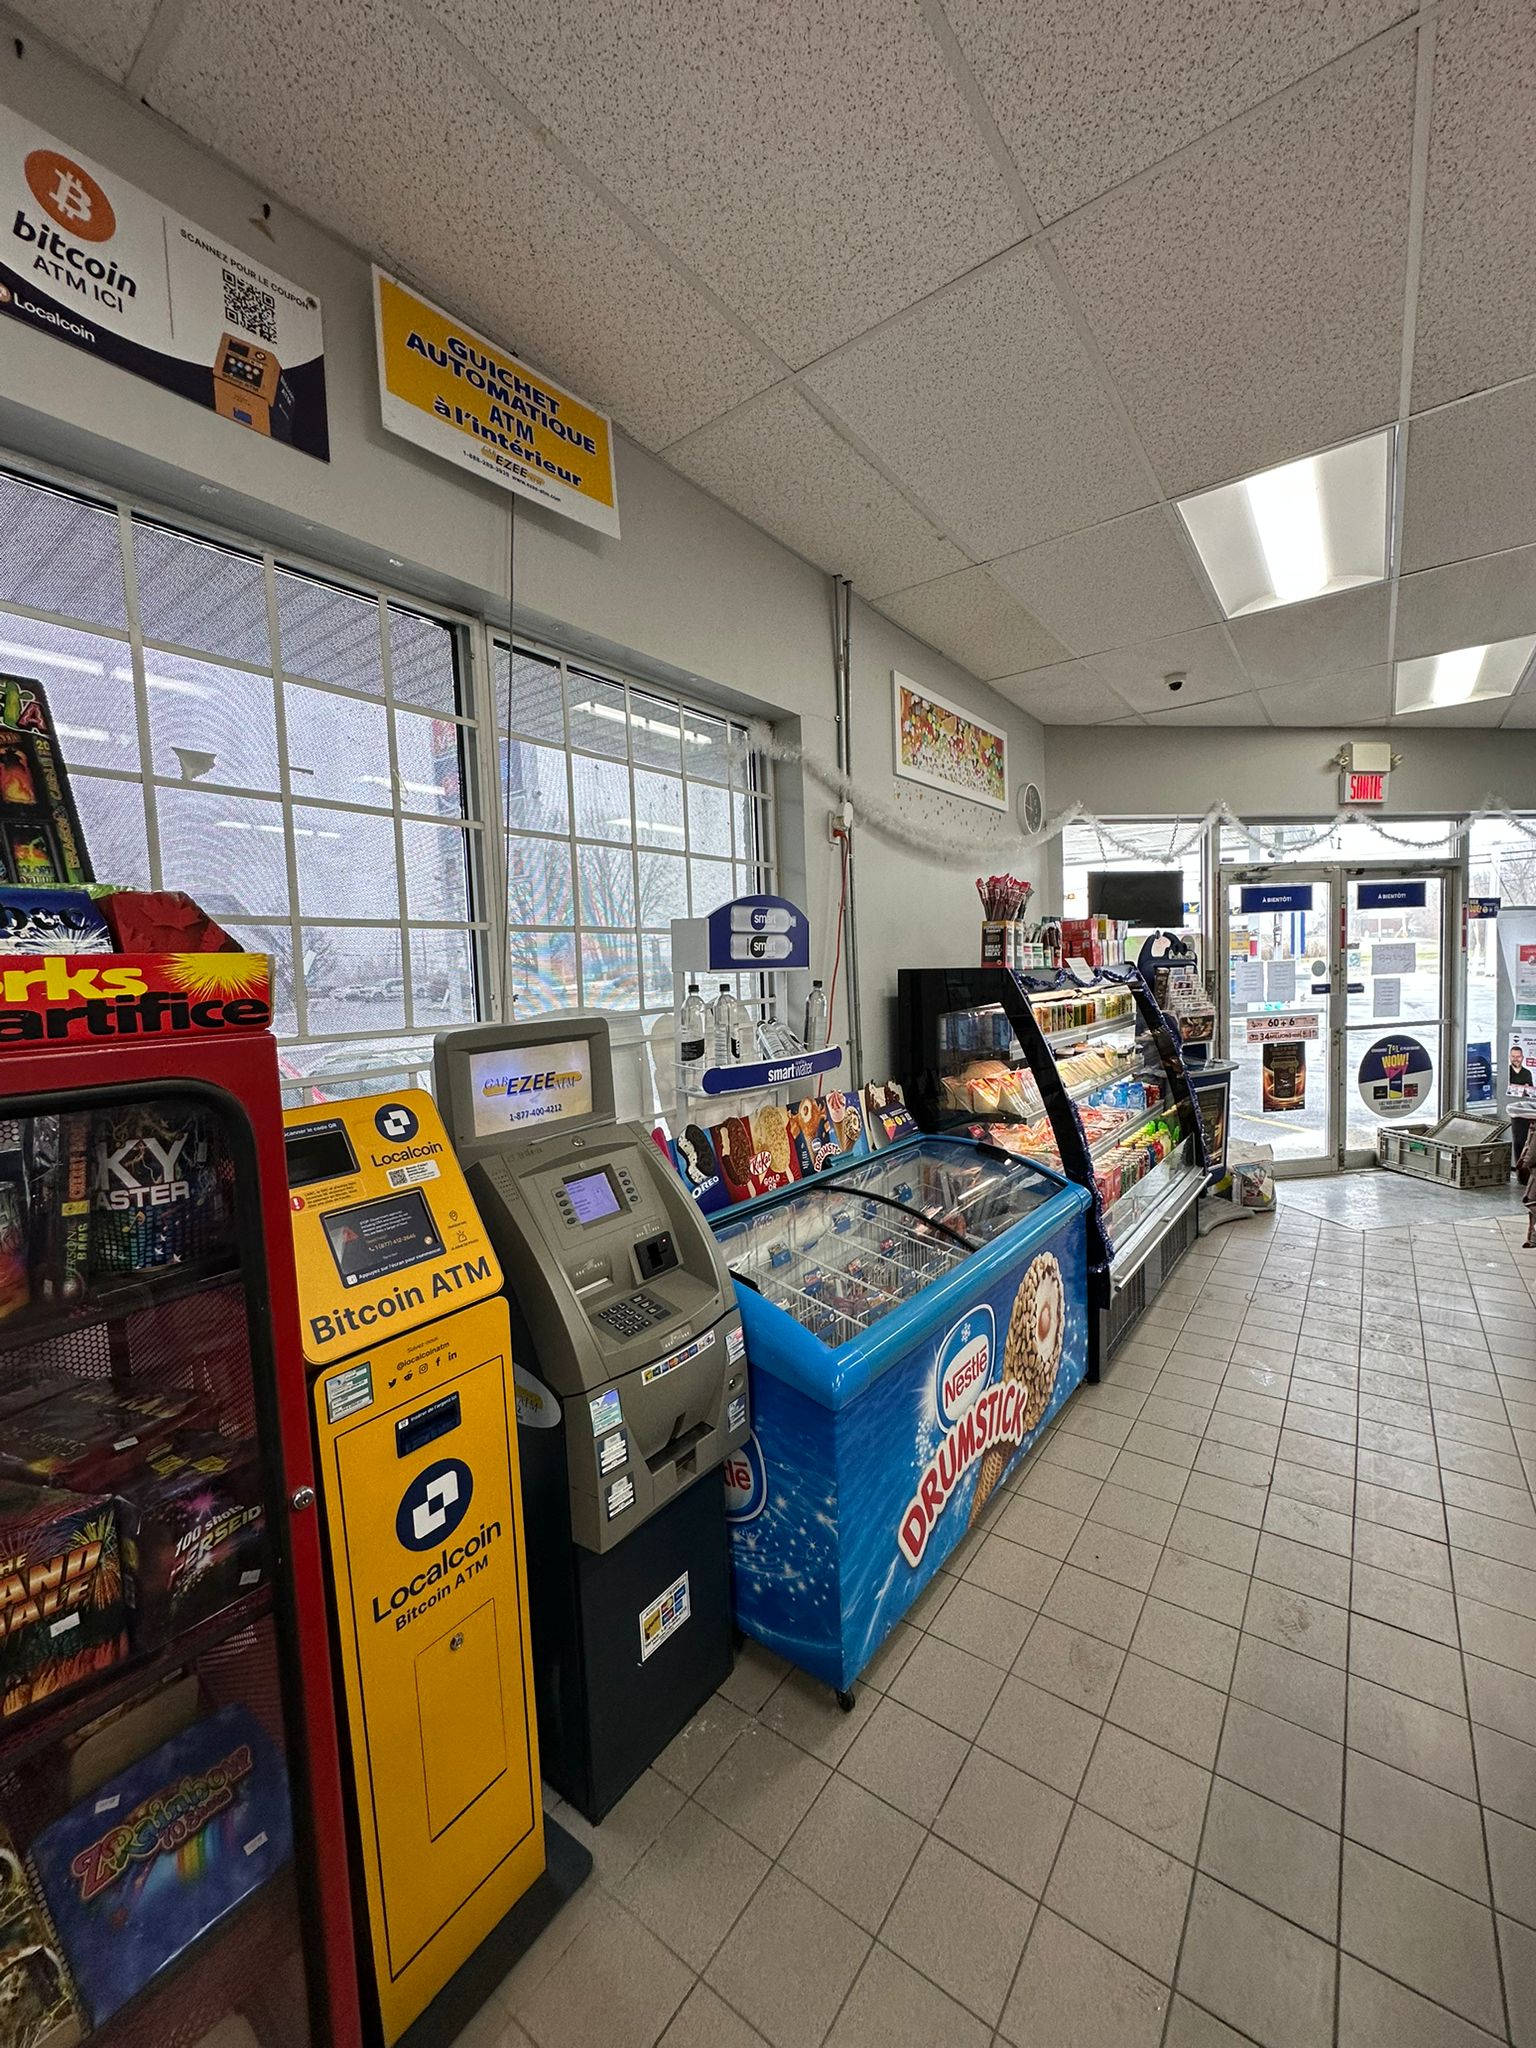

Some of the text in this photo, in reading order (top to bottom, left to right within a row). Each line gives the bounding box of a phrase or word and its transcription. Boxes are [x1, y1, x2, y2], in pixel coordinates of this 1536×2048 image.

[13, 210, 137, 298] bitcoin
[180, 229, 228, 263] SCANNEZ
[230, 258, 256, 280] POUR
[258, 274, 269, 288] LE
[33, 255, 123, 314] ATM ICI
[13, 292, 96, 343] Localcoin
[406, 332, 596, 455] AUTOMATIQUE
[447, 336, 560, 415] GUICHET
[434, 394, 582, 487] à l'intérieur
[489, 404, 535, 445] ATM
[496, 454, 528, 479] EZEE
[1350, 775, 1384, 800] SORTIE
[0, 958, 148, 1002] rks
[1260, 1033, 1270, 1041] 34
[1268, 1019, 1279, 1027] 60
[1289, 1018, 1295, 1026] 6
[1382, 1052, 1409, 1069] WOW!
[507, 1071, 556, 1096] EZEE
[510, 1103, 562, 1122] 1-877-400-4212
[371, 1141, 443, 1168] Localcoin
[691, 1176, 719, 1199] OREO
[763, 1173, 781, 1186] GOLD
[768, 1183, 777, 1192] OR
[310, 1256, 492, 1345] Bitcoin ATM
[396, 1342, 450, 1371] @localcoinatm
[945, 1344, 988, 1409] Nestlé
[902, 1383, 1027, 1558] DRUMSTICK
[175, 1505, 245, 1558] 100 shots
[372, 1521, 502, 1624] Localcoin
[395, 1555, 489, 1632] Bitcoin ATM
